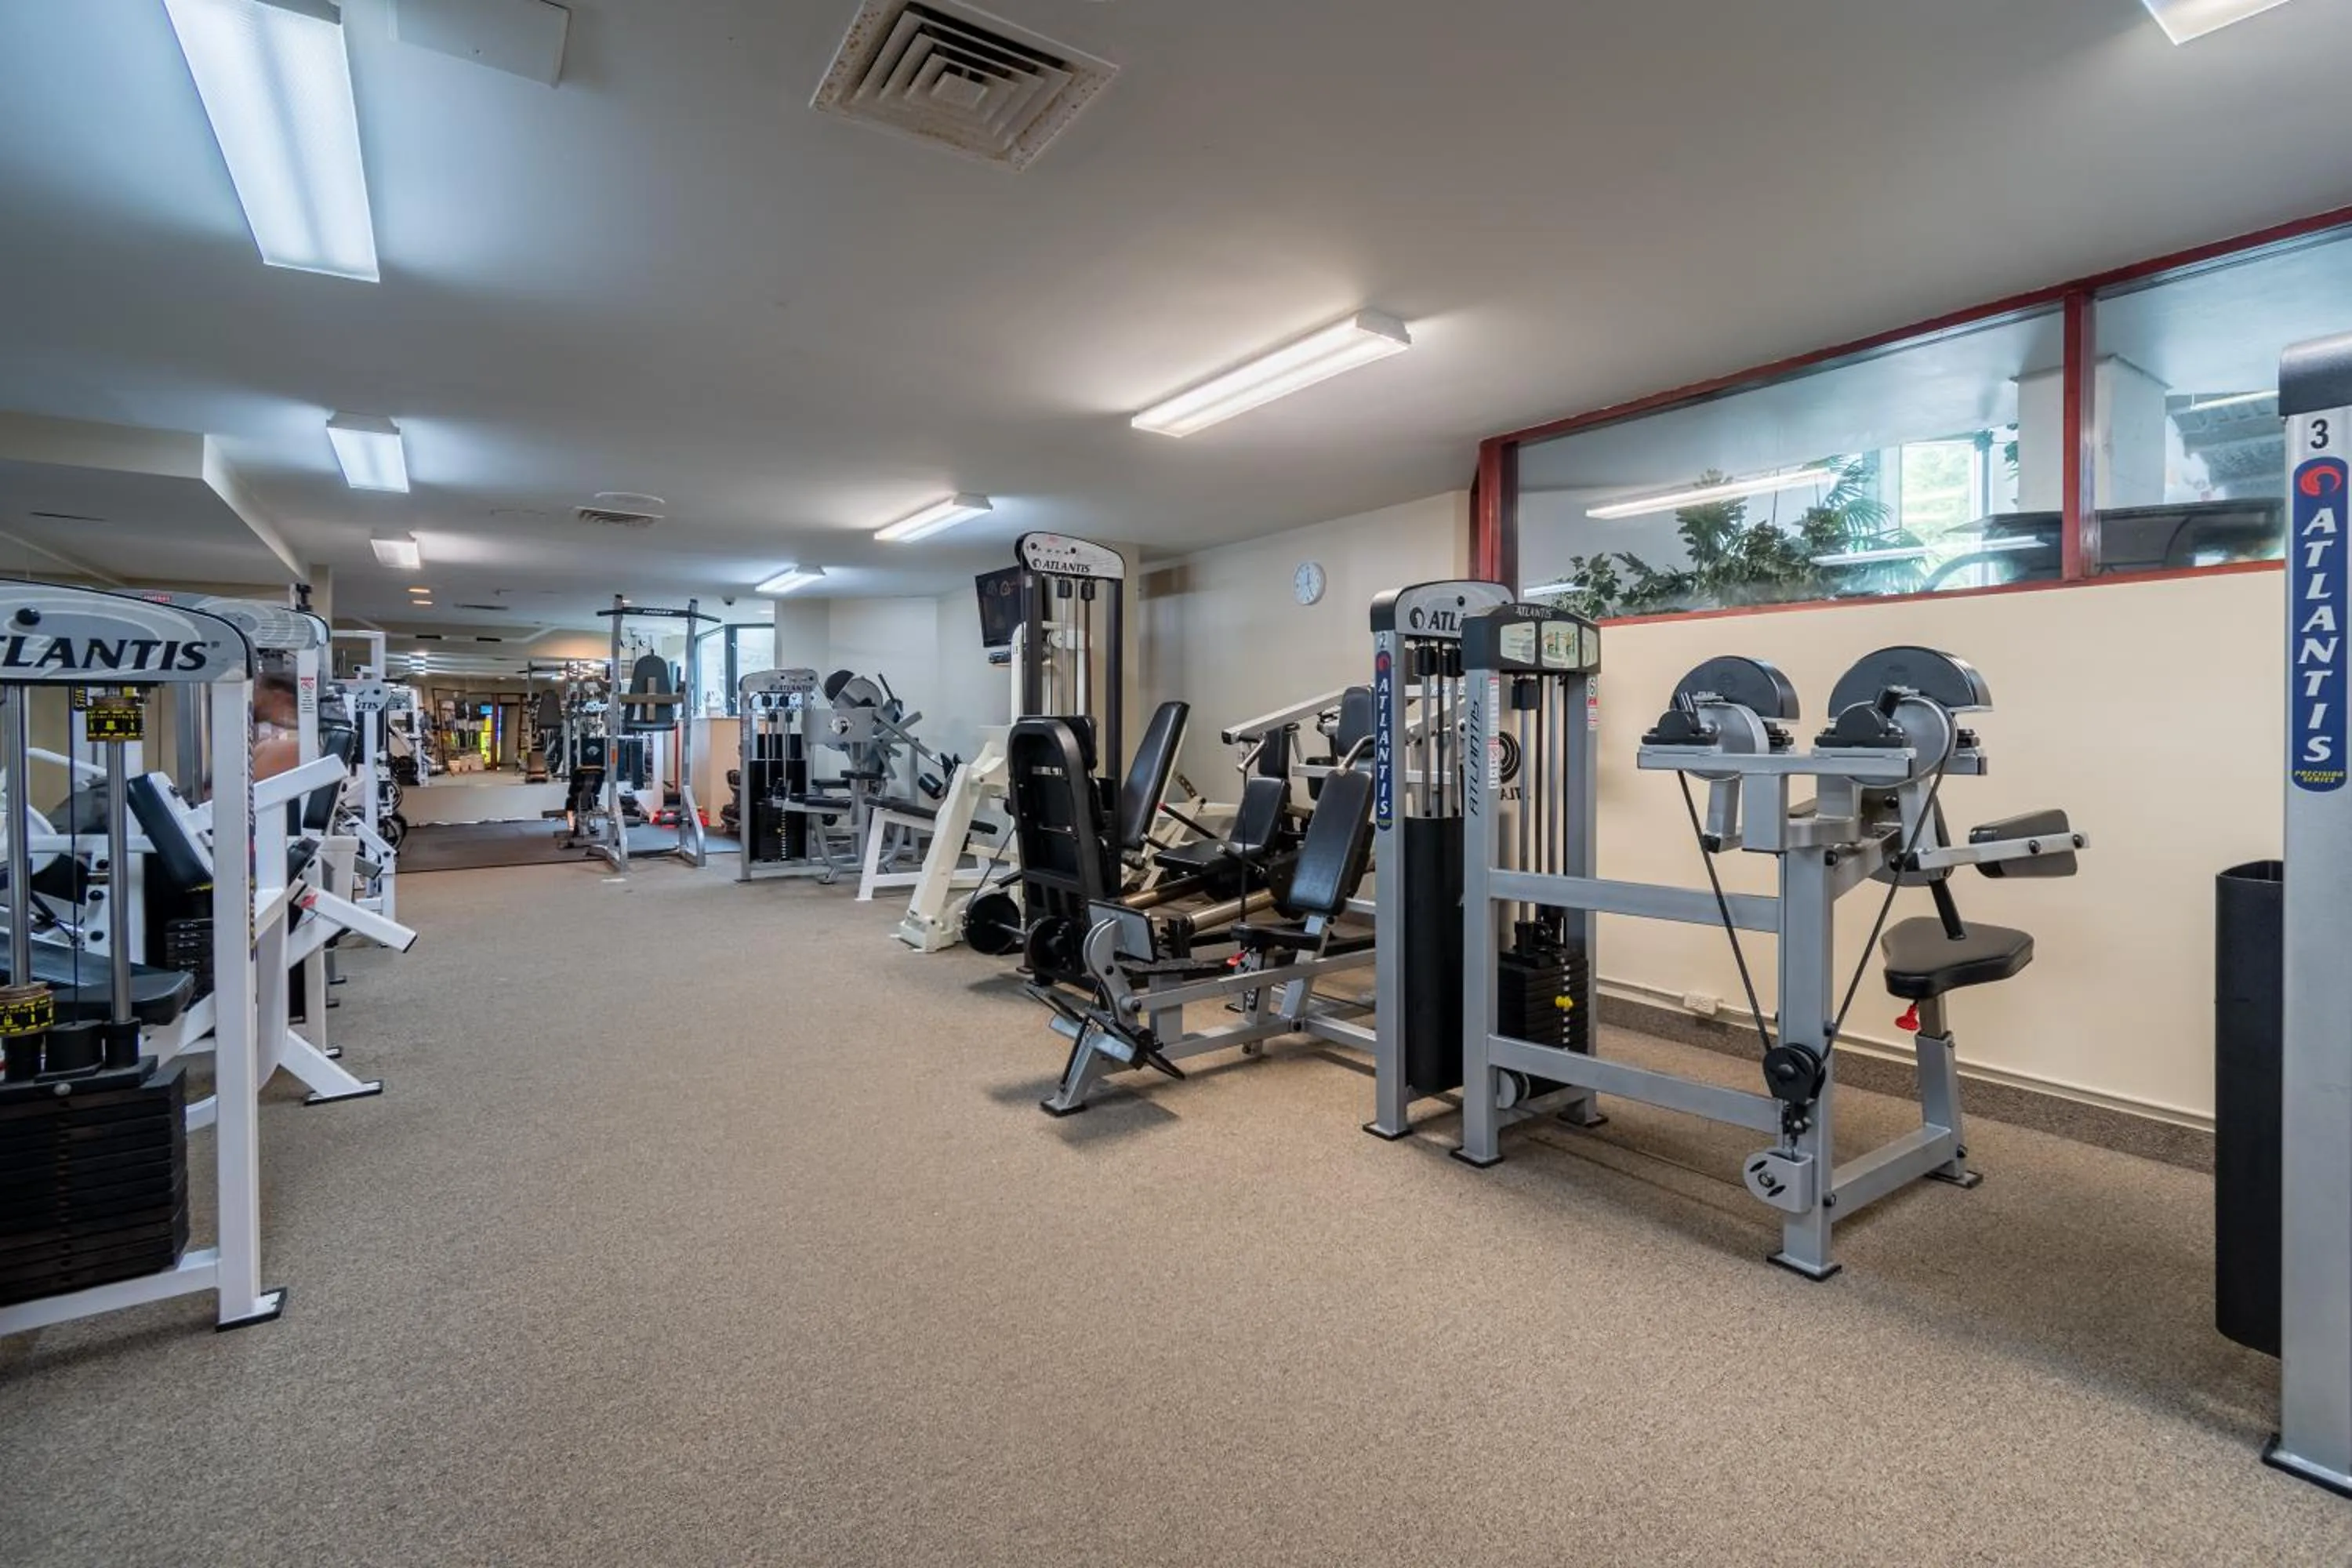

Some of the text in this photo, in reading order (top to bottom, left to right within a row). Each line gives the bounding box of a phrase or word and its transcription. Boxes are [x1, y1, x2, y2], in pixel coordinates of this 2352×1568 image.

[2310, 419, 2329, 448] 3
[1043, 560, 1091, 573] ATLANTIS
[1428, 610, 1462, 632] ATL
[1516, 605, 1552, 618] ATLANTIS
[1379, 632, 1387, 648] 2
[2299, 507, 2339, 763] ATLANTIS
[0, 636, 208, 671] LANTIS
[1377, 677, 1390, 815] ATLANTIS
[1468, 700, 1479, 816] ATLANTIS
